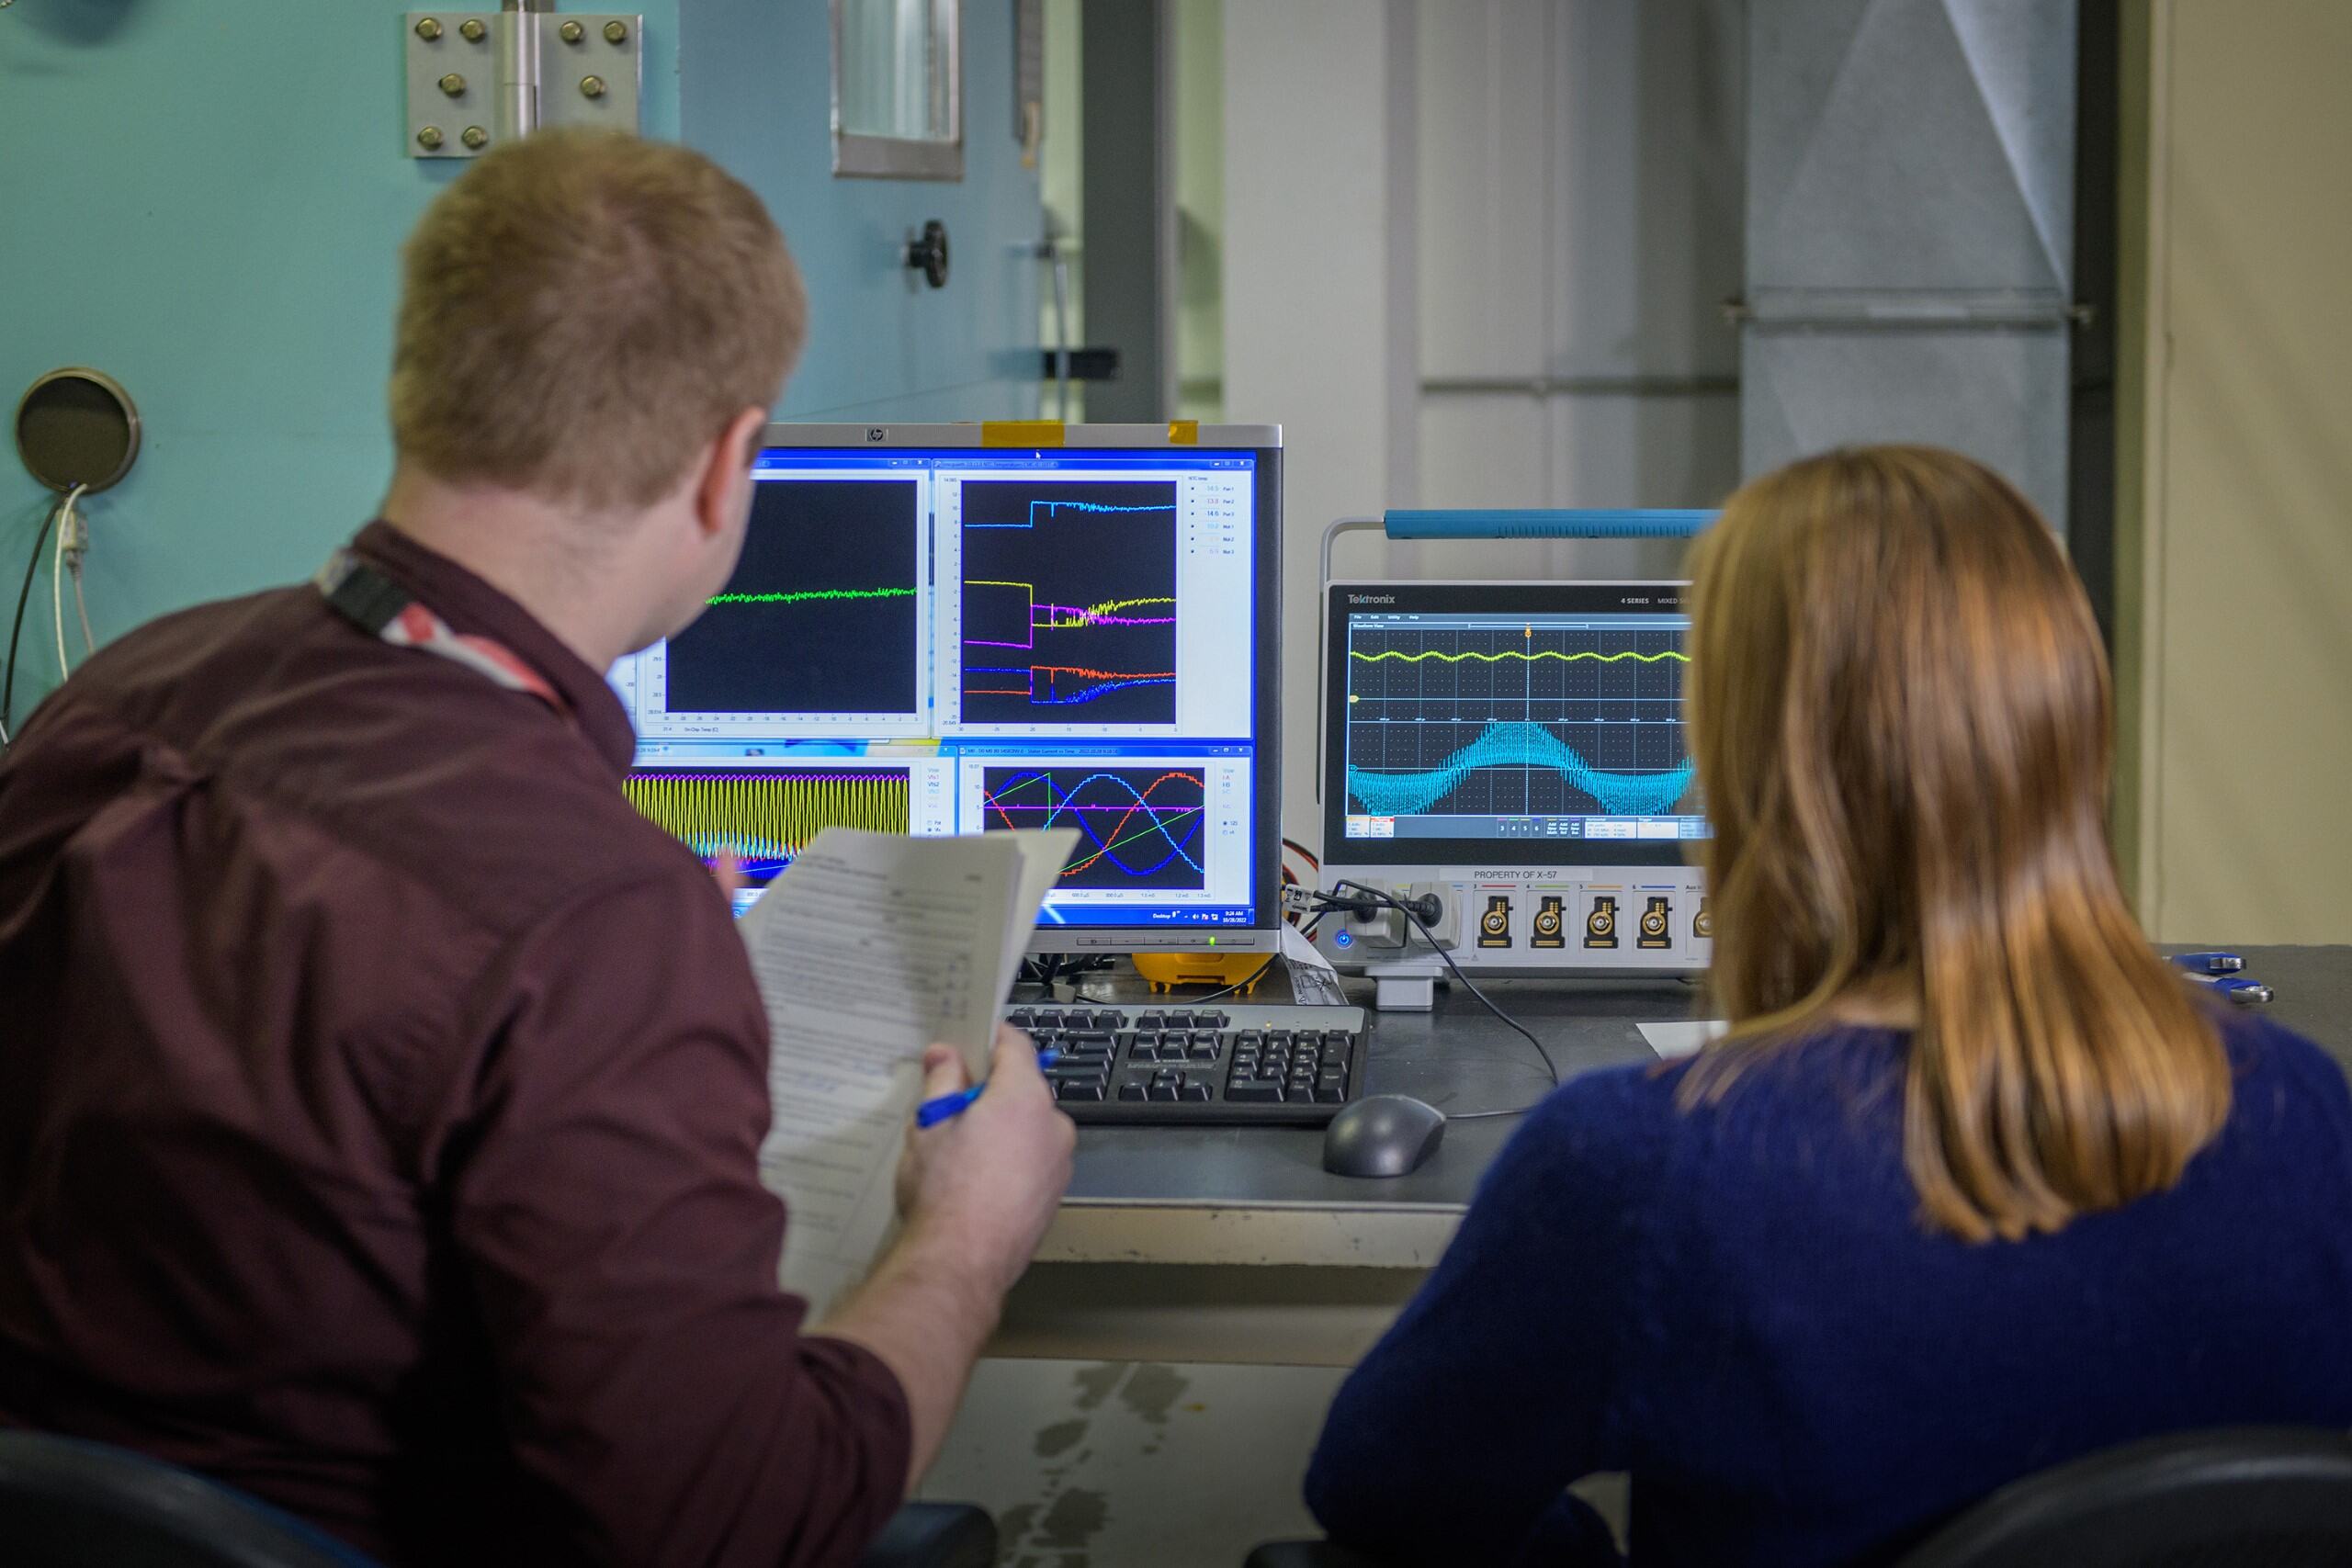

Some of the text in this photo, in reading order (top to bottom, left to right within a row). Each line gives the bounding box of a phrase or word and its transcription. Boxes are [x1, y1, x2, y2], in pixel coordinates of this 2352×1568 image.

[1348, 593, 1396, 604] Tektronix
[1474, 871, 1557, 879] PROPERTY OF X-57
